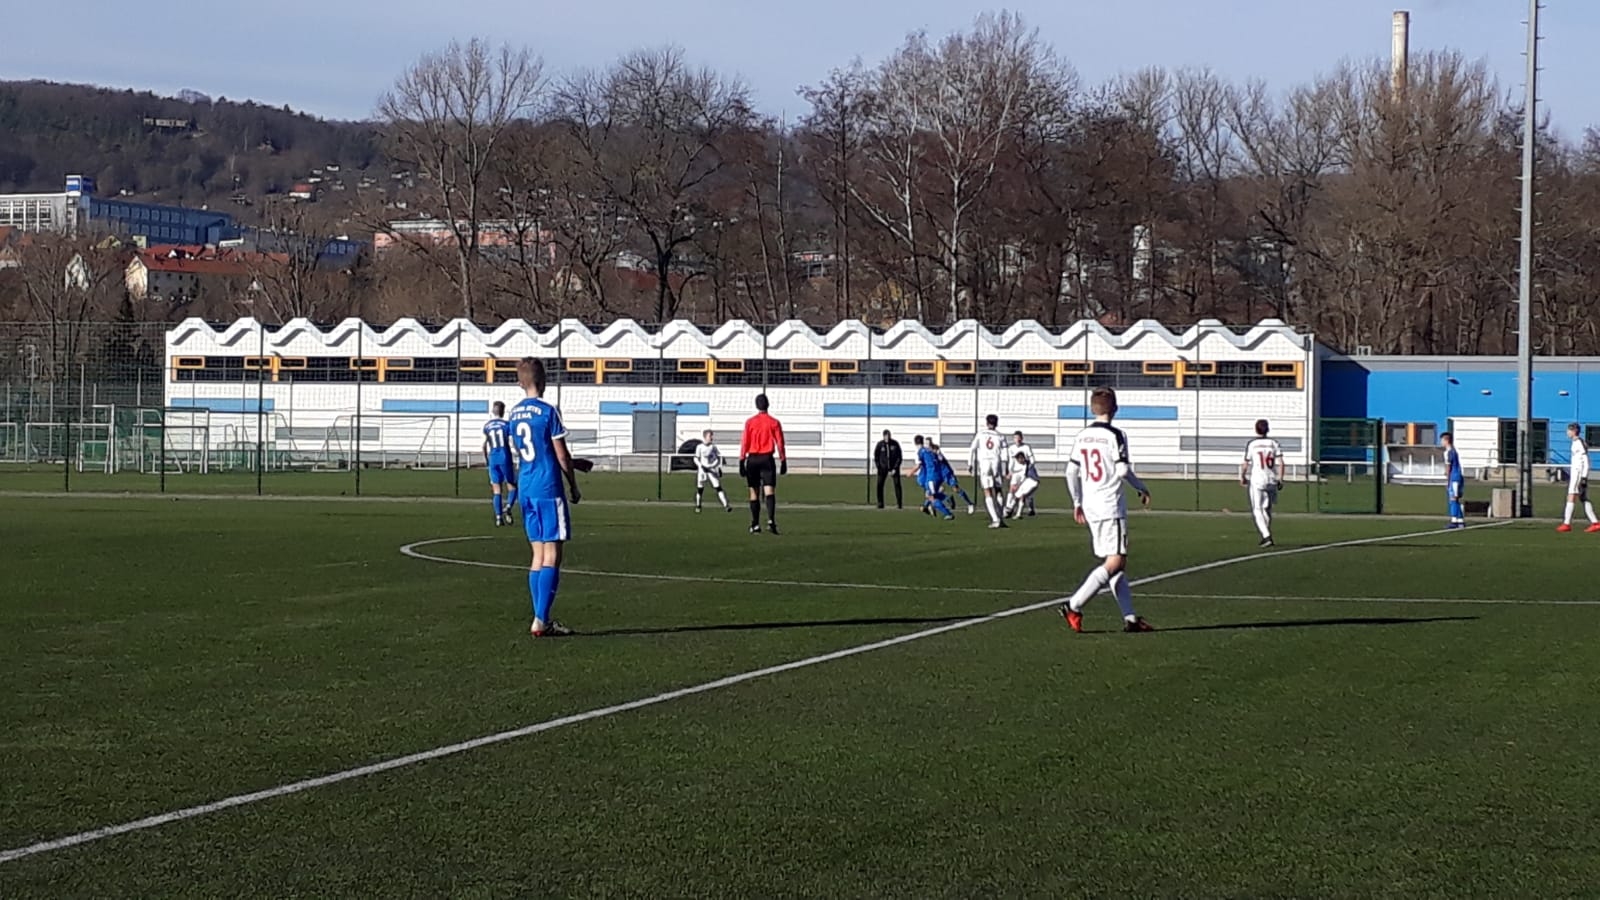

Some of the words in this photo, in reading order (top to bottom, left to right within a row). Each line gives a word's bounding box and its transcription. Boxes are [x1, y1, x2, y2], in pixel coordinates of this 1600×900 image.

[489, 429, 505, 448] 11
[516, 422, 535, 462] 3
[986, 437, 995, 450] 6
[1080, 449, 1103, 482] 13
[1257, 451, 1274, 469] 16
